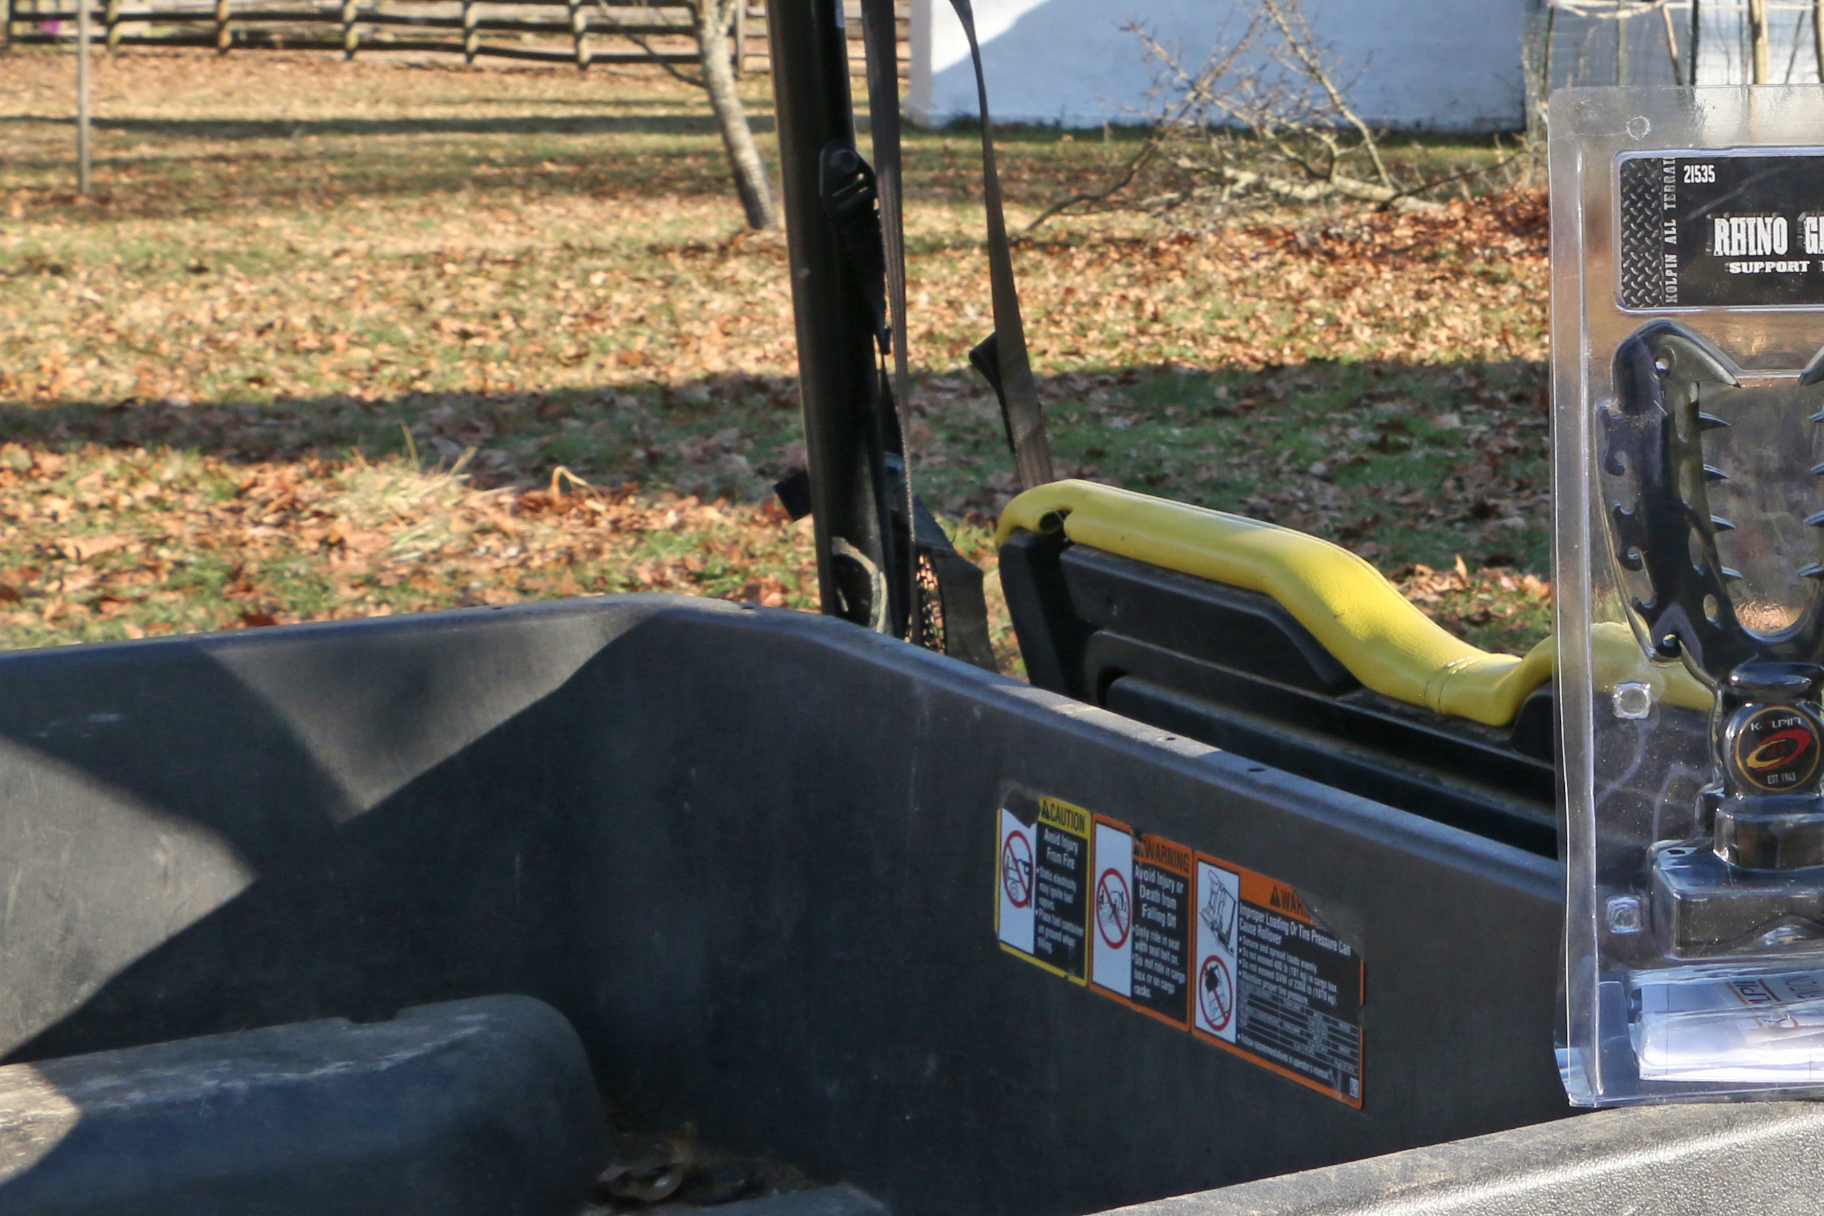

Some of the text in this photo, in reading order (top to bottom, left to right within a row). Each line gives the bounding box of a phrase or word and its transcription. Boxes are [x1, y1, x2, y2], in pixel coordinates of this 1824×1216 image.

[1683, 164, 1716, 183] 21535
[1664, 219, 1677, 244] ALL
[1713, 216, 1788, 256] RHINO
[1665, 254, 1678, 304] KOLPIN
[1728, 260, 1810, 274] SUPPORT
[1050, 804, 1086, 834] CAUTION
[1063, 854, 1075, 869] Fire
[1145, 840, 1189, 872] WARNING
[1135, 864, 1183, 894] Avoid Injury or
[1140, 885, 1176, 909] Death from
[1142, 903, 1176, 928] Falling Off
[1291, 923, 1297, 935] Or
[1299, 926, 1310, 940] Tire
[1339, 940, 1351, 956] Can
